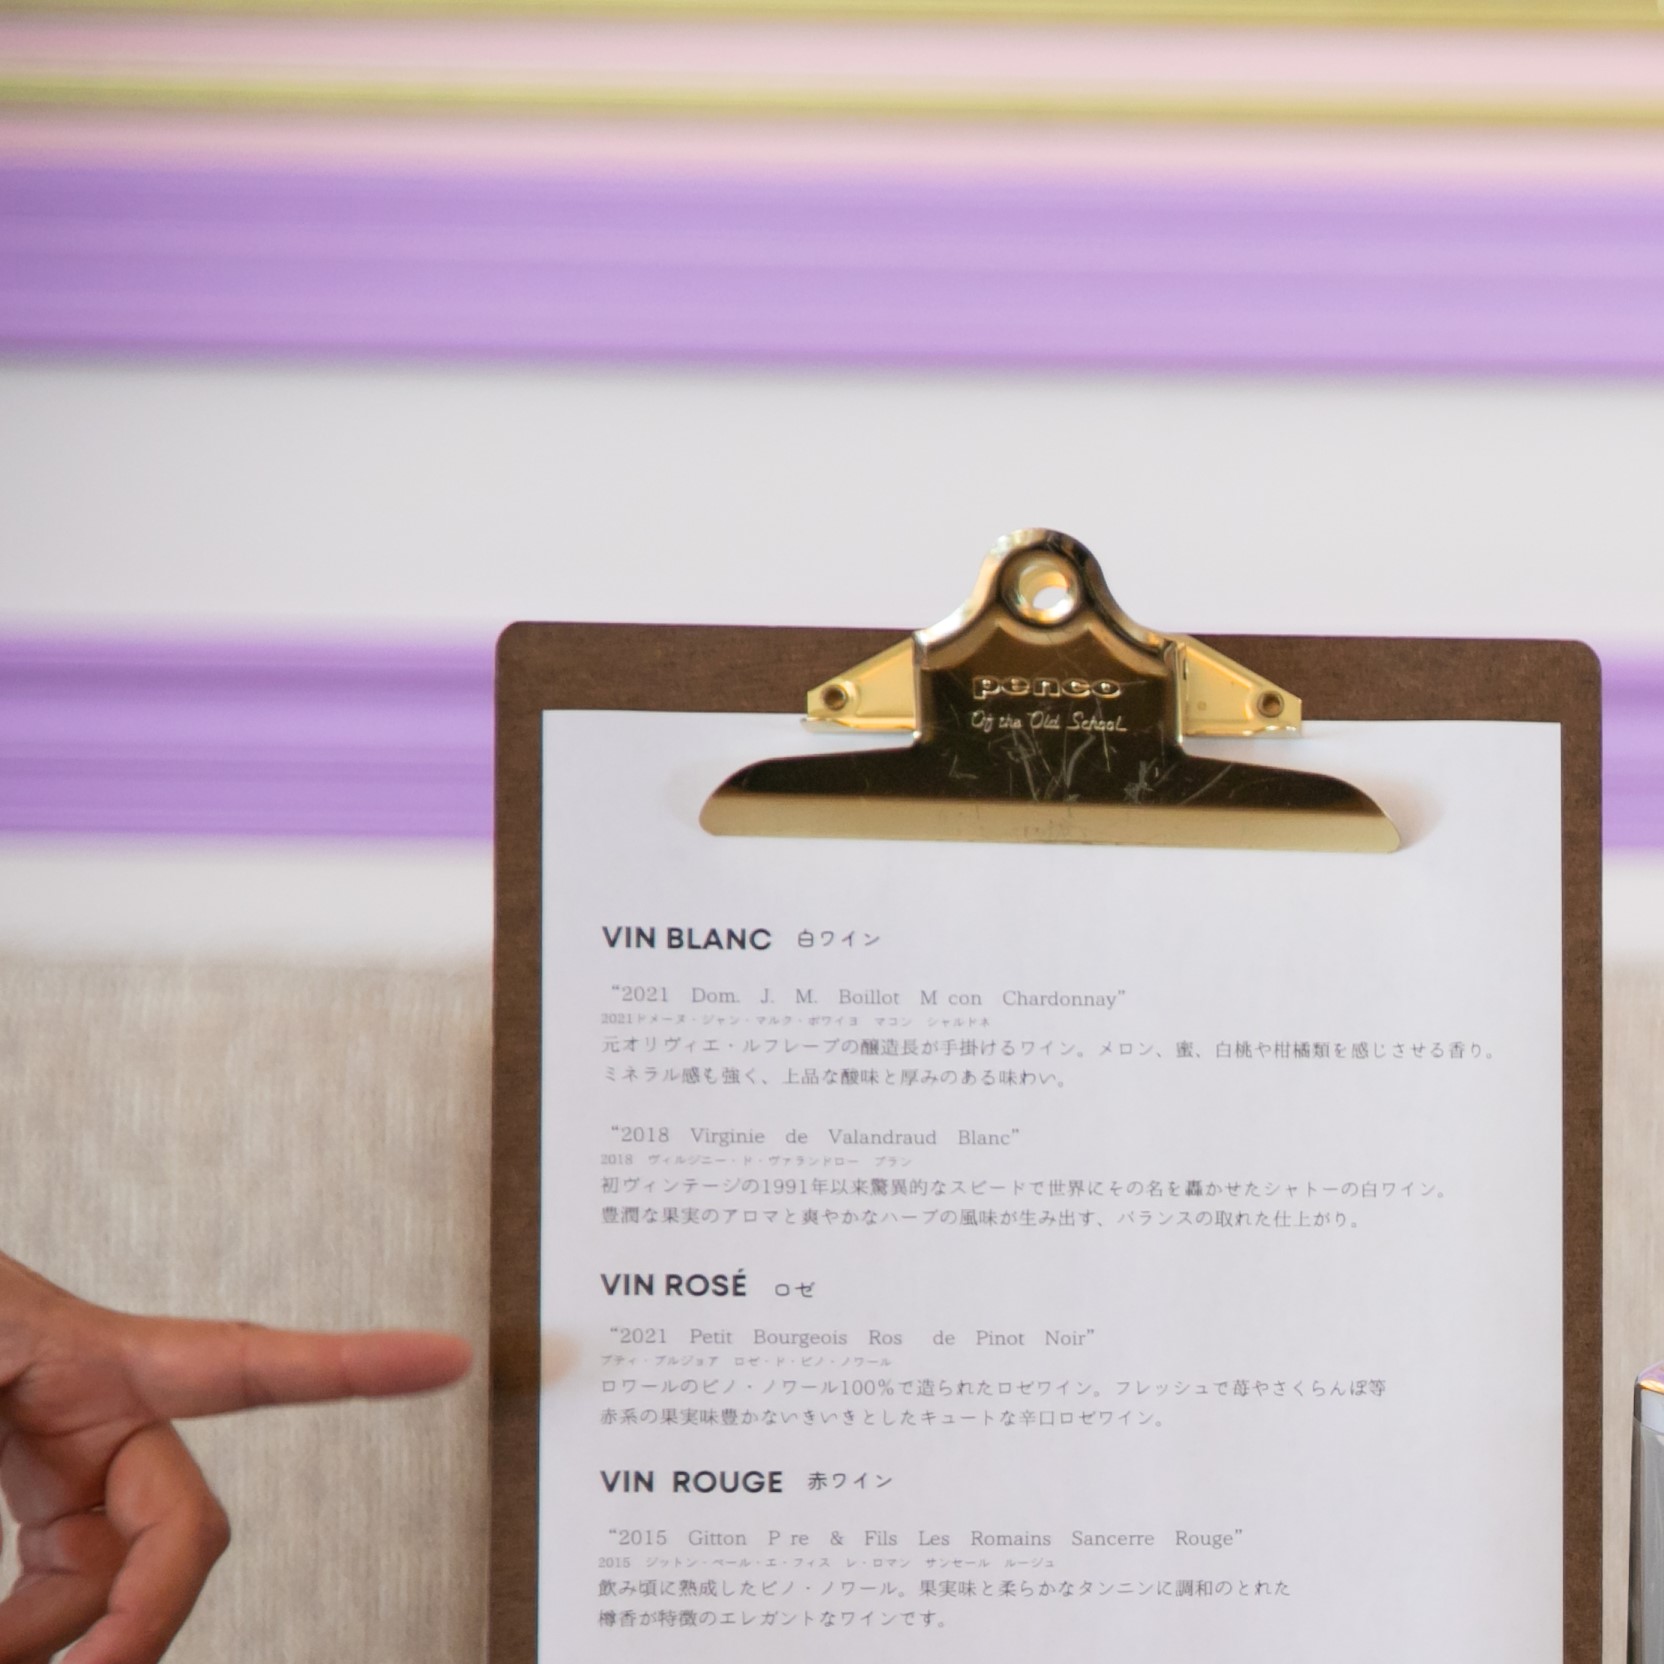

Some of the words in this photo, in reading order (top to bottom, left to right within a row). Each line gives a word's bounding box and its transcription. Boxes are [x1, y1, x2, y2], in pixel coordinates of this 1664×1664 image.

[972, 675, 1121, 700] penco
[970, 709, 994, 733] Of
[998, 713, 1023, 729] the
[1027, 710, 1061, 729] Old
[1066, 711, 1128, 731] School
[601, 925, 657, 950] VIN
[665, 926, 774, 952] BLANC
[797, 927, 881, 949] 白ワイン
[691, 986, 741, 1004] Dom.
[759, 987, 775, 1005] J.
[795, 987, 818, 1005] M.
[838, 988, 900, 1006] Boillot
[947, 993, 983, 1006] con
[690, 1127, 766, 1148] Virginie
[785, 1128, 809, 1145] de
[827, 1128, 937, 1146] Valandraud
[599, 1152, 635, 1166] 2018
[599, 1272, 656, 1297] VIN
[664, 1267, 748, 1298] ROSÉ
[774, 1280, 816, 1299] ロゼ
[689, 1327, 733, 1345] Petit
[753, 1328, 848, 1349] Bourgeois
[868, 1329, 903, 1346] Ros
[932, 1329, 956, 1346] de
[975, 1329, 1025, 1346] Pinot
[599, 1469, 656, 1494] VIN
[671, 1469, 784, 1495] ROUGE
[807, 1470, 893, 1492] 赤ワイン
[687, 1529, 748, 1546] Gitton
[790, 1533, 810, 1547] re
[829, 1530, 845, 1547] &
[864, 1529, 898, 1547] Fils
[918, 1529, 951, 1547] Les
[970, 1529, 1052, 1547] Romains
[1071, 1529, 1155, 1547] Sancerre
[597, 1556, 631, 1569] 2015
